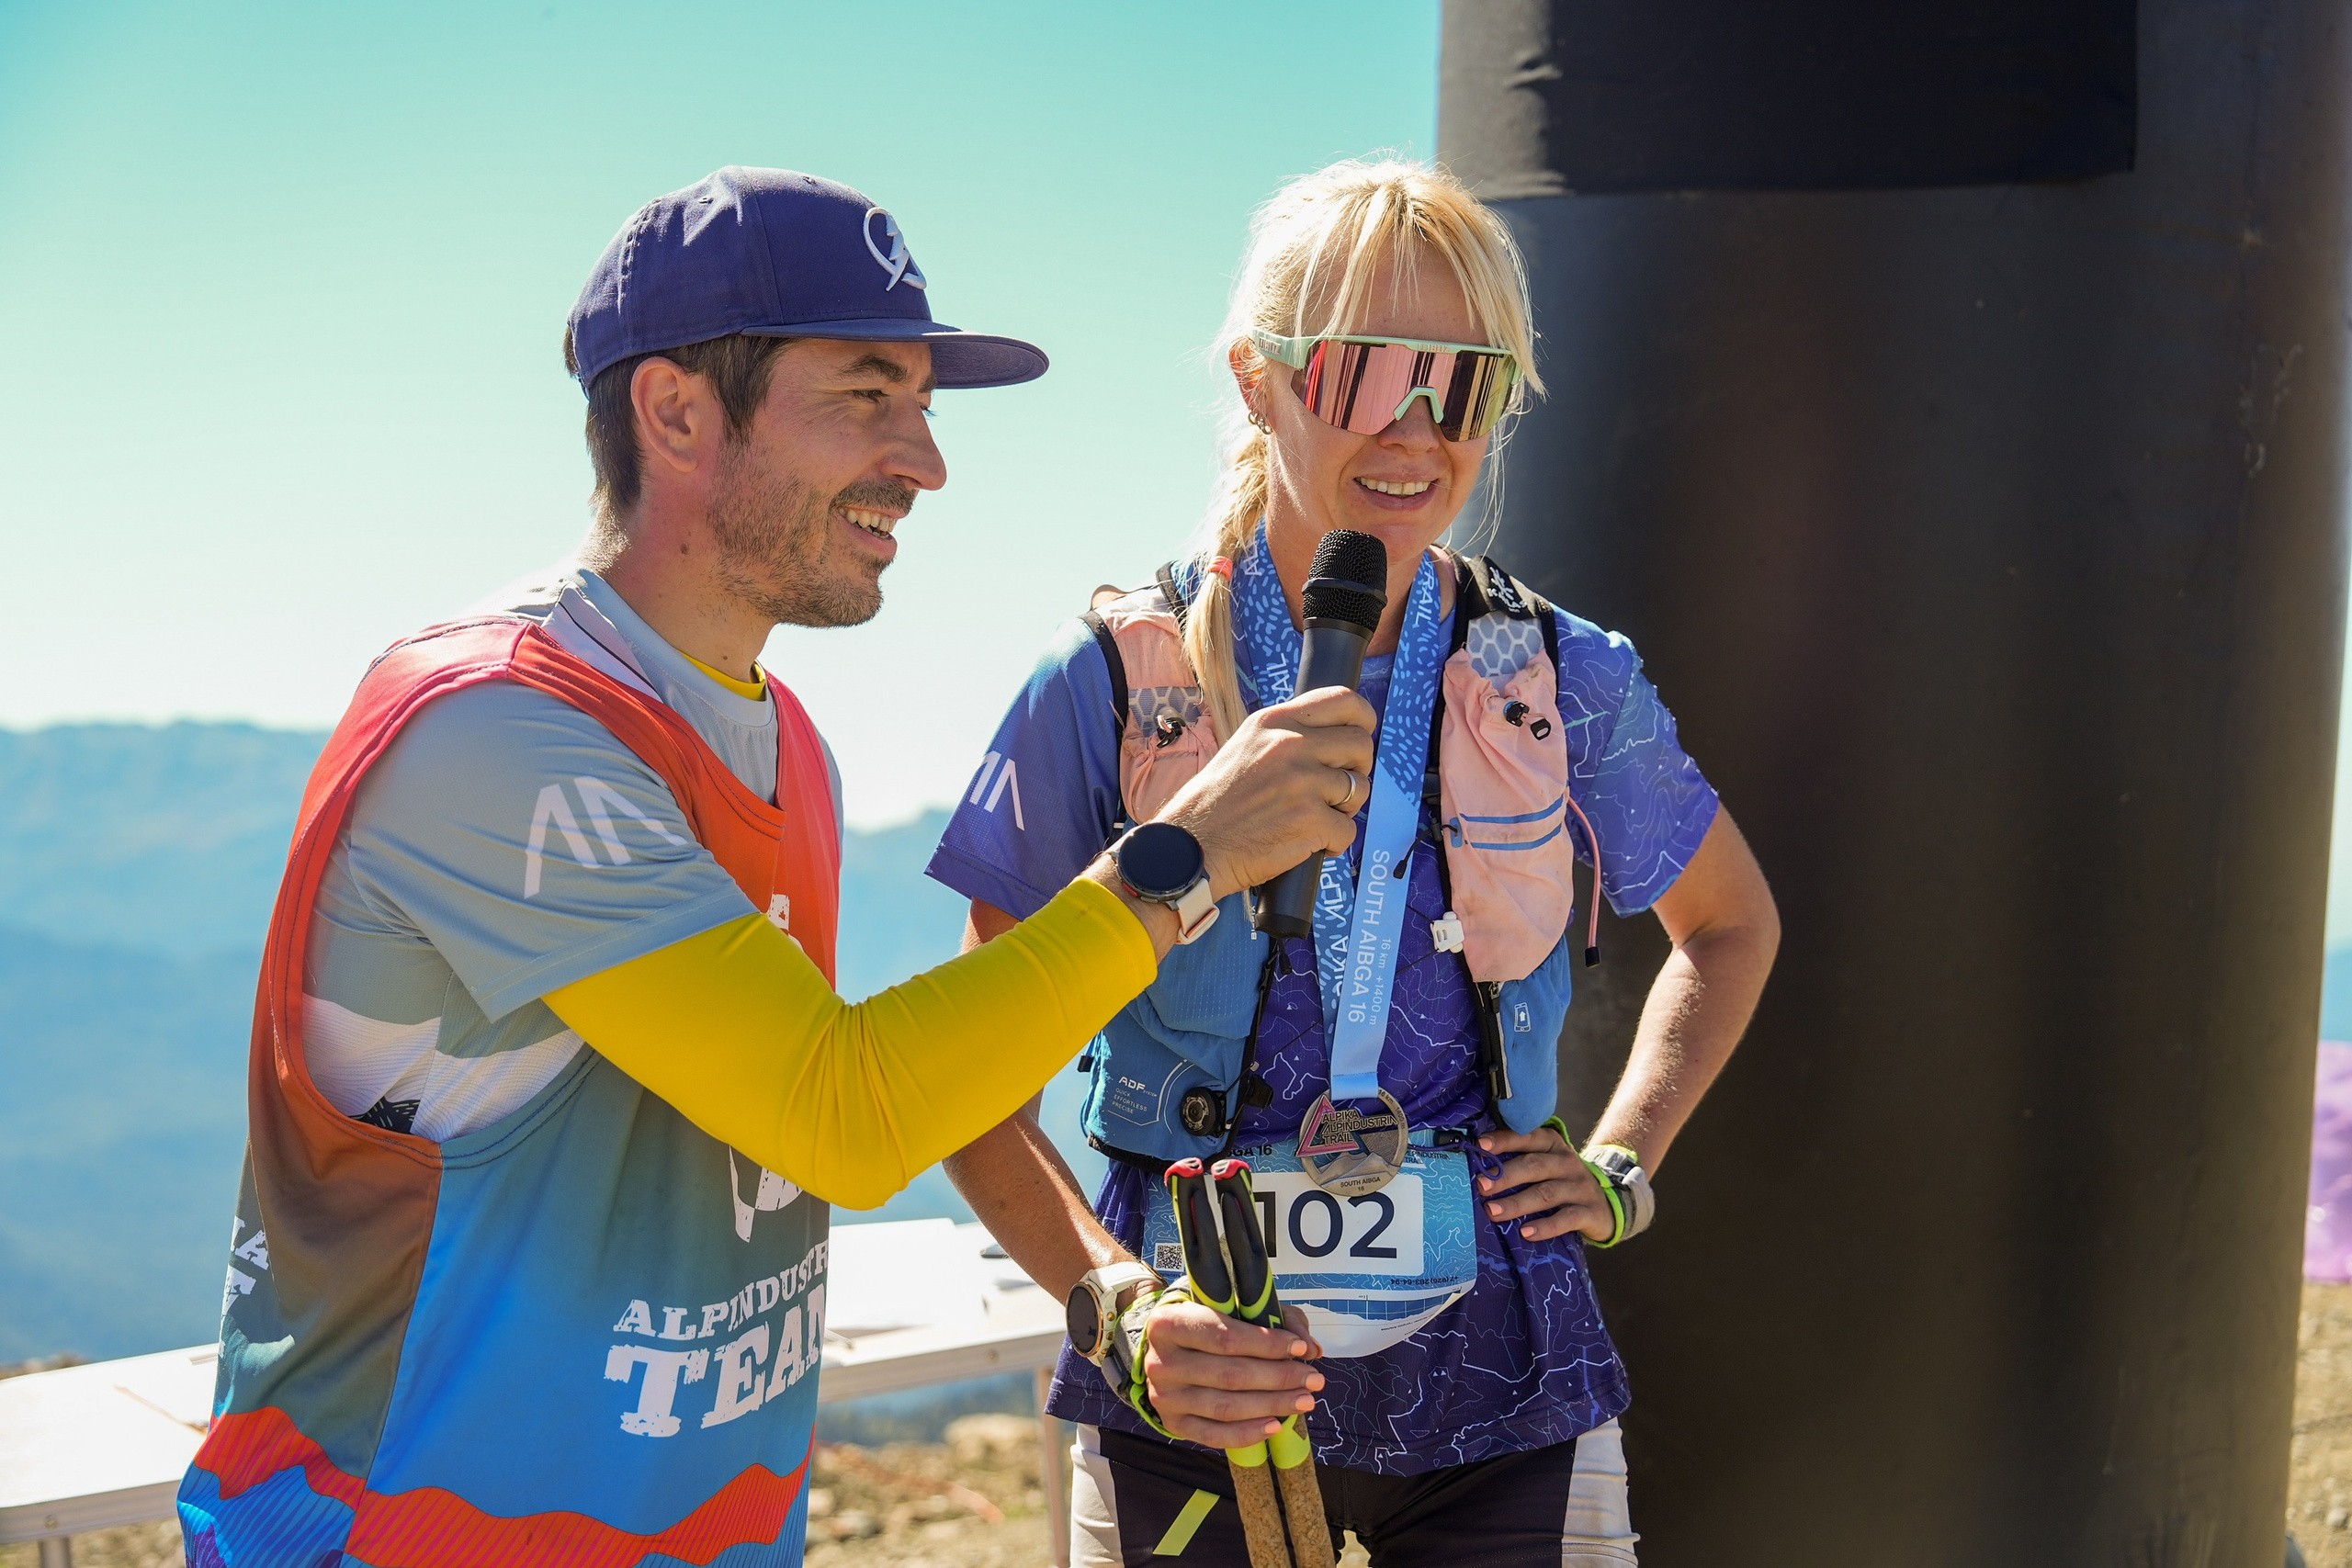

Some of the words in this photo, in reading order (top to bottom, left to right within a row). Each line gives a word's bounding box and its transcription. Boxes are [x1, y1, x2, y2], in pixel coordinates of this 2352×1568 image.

[1266, 652, 1295, 705] RAIL
[1363, 849, 1390, 925] SOUTH
[1381, 938, 1392, 951] 16
[1351, 929, 1377, 999] AIBGA
[1378, 953, 1388, 969] km
[1371, 976, 1385, 1012] +1400
[1348, 1001, 1366, 1023] 16
[1369, 1015, 1377, 1025] m
[1118, 1076, 1146, 1091] ADF
[1112, 1100, 1134, 1114] PRECISE
[1114, 1094, 1148, 1111] EFFORTLESS
[1322, 1109, 1359, 1123] ALPIKA
[1323, 1133, 1353, 1146] TRAIL
[1257, 1144, 1273, 1156] 16
[1340, 1179, 1362, 1189] SOUTH
[1253, 1190, 1397, 1259] 102
[613, 1239, 828, 1340] ALPINDUSTR
